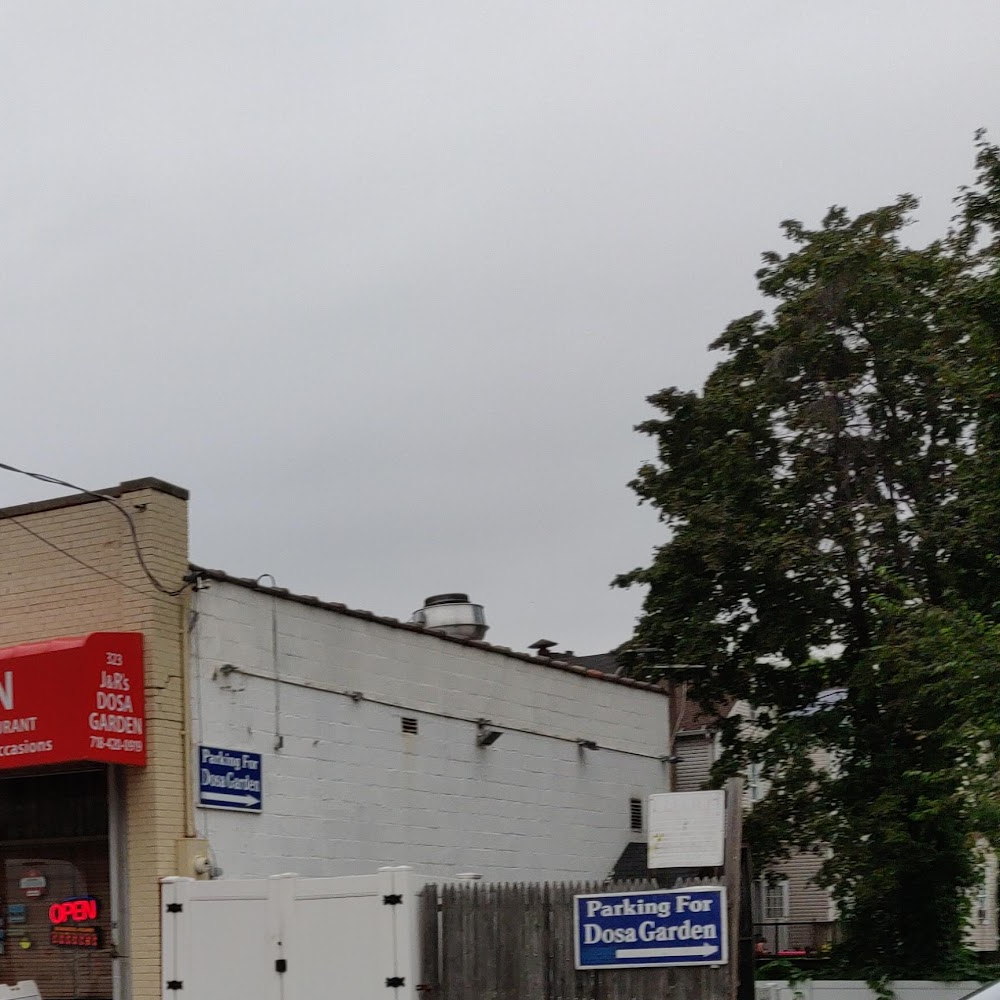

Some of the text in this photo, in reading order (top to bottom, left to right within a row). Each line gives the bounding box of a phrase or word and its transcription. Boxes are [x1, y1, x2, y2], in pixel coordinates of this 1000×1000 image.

[106, 652, 123, 666] 323
[100, 671, 130, 691] J&R's
[96, 691, 133, 713] DOSA
[89, 712, 143, 735] GARDEN
[49, 899, 97, 924] OPEN
[586, 895, 714, 919] Parking For
[583, 920, 718, 945] Dosa Garden
